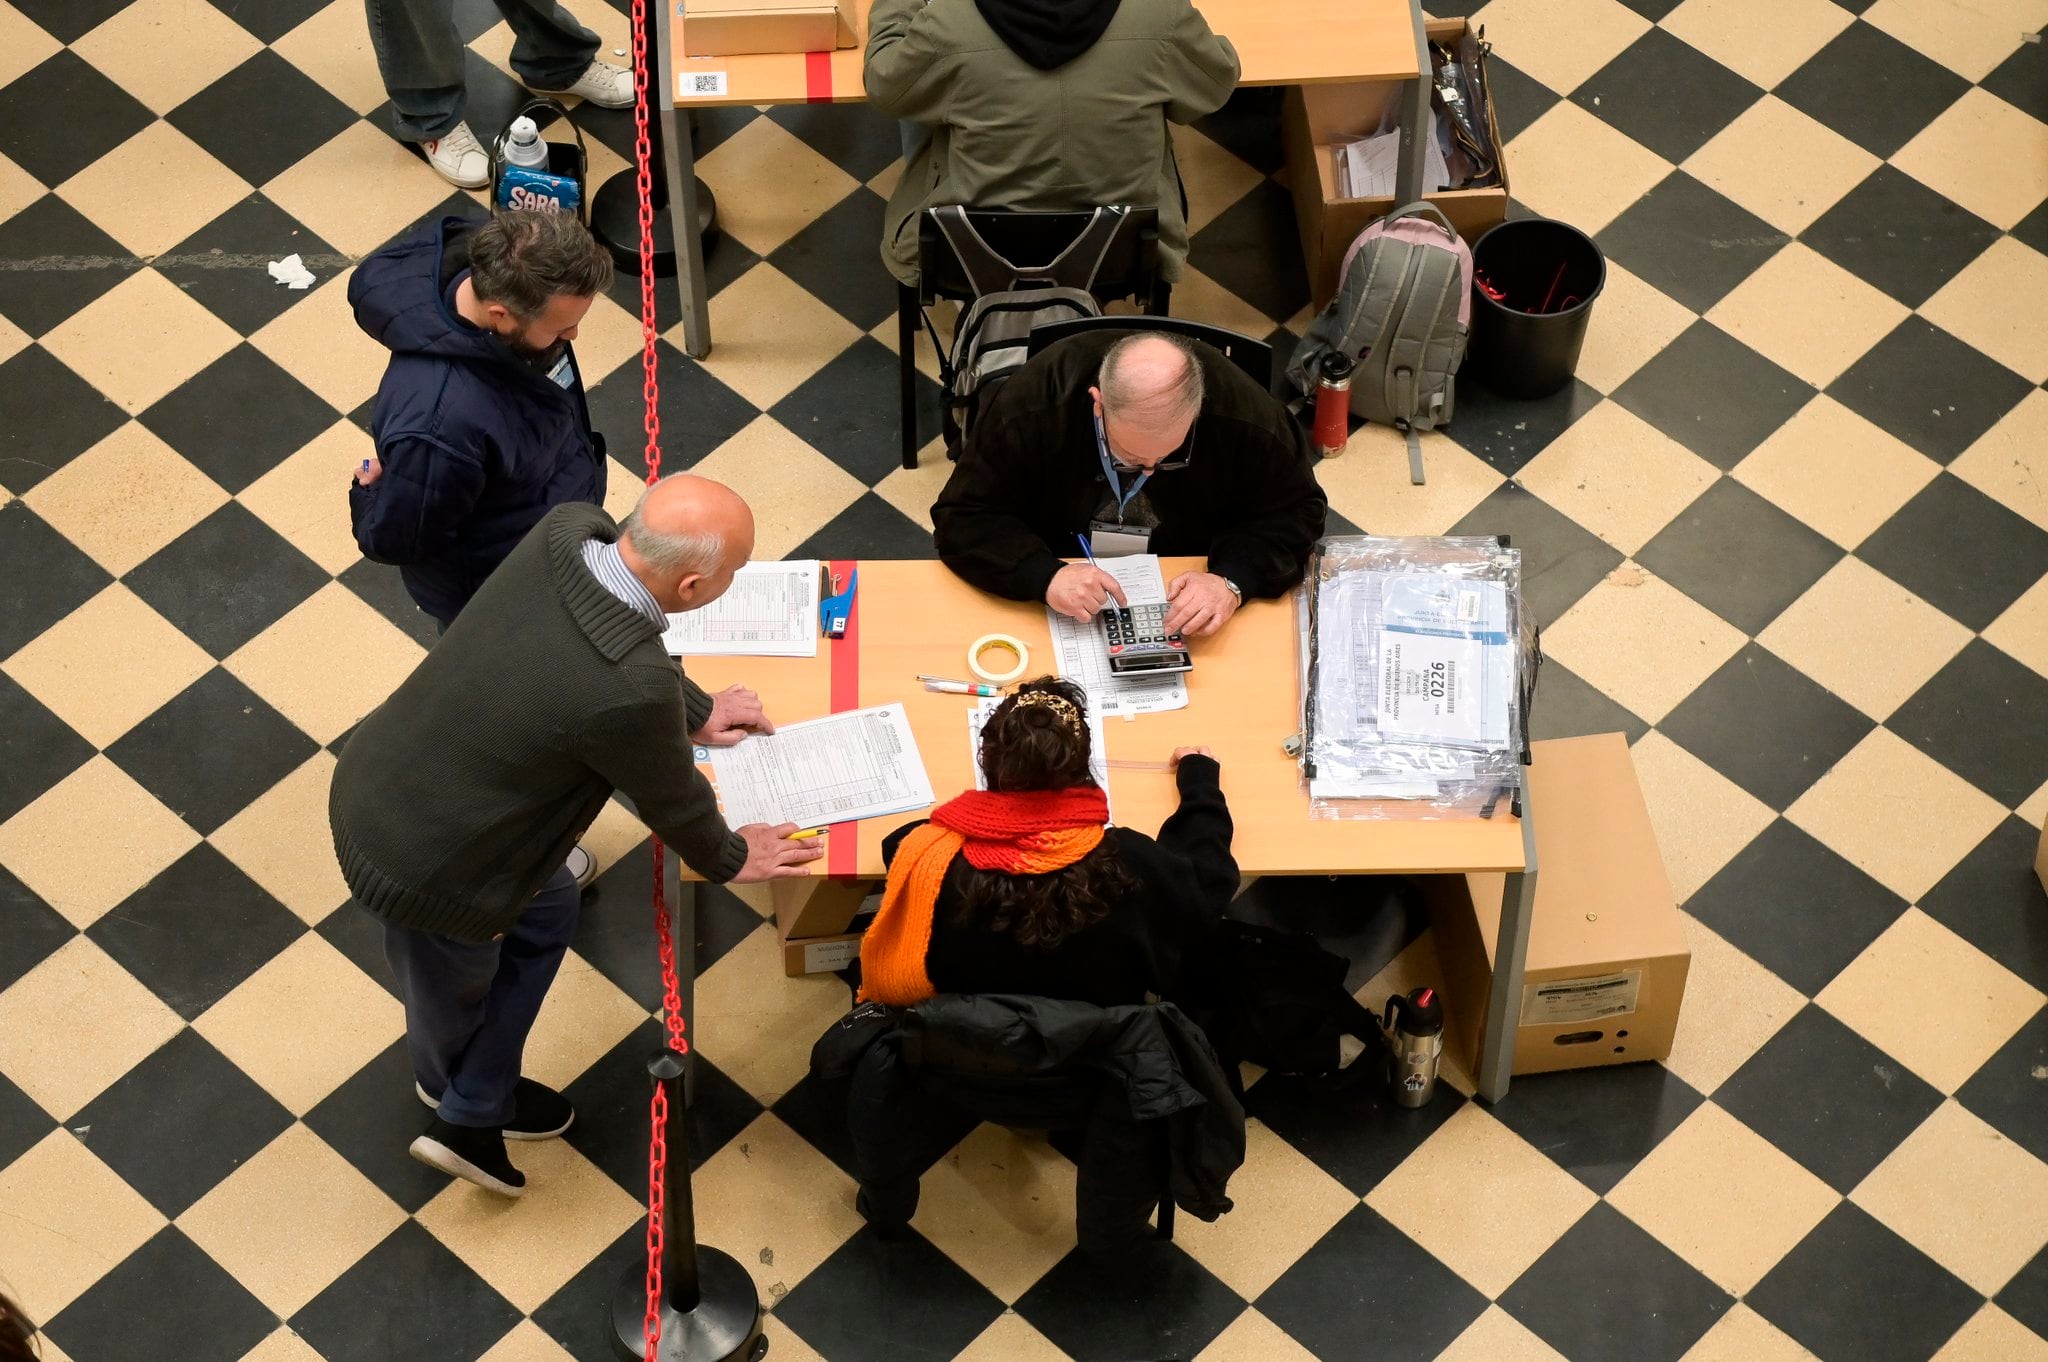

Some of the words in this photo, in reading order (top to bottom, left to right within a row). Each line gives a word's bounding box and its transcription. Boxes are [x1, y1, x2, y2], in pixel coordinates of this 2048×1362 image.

[508, 186, 560, 214] SARA
[1385, 648, 1392, 656] LA
[1385, 657, 1392, 665] DE
[1394, 683, 1401, 691] DE
[1422, 669, 1430, 702] CAMPANA
[1430, 662, 1445, 698] 0226
